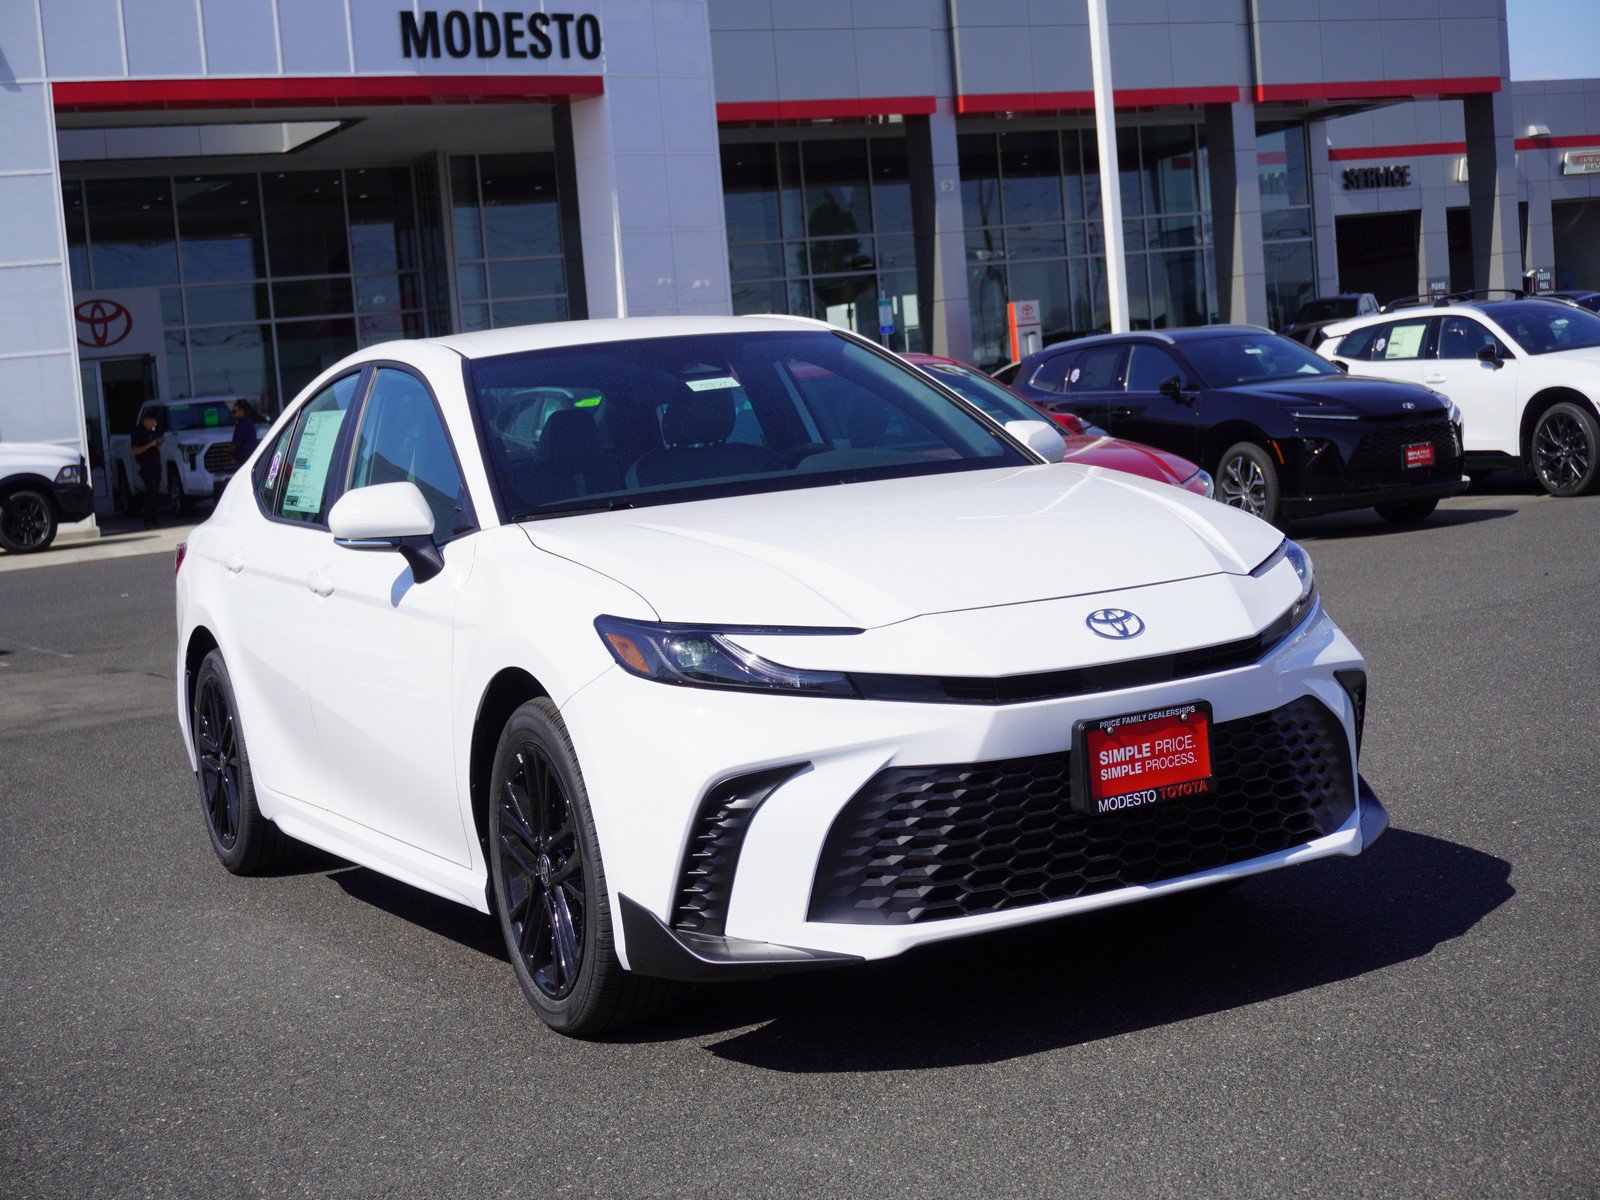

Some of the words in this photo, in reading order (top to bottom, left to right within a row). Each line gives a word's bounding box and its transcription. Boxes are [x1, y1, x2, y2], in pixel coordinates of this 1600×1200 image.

[399, 10, 601, 60] MODESTO
[1343, 165, 1411, 190] SERVICE
[1100, 718, 1120, 729] PRICE
[1122, 714, 1147, 725] FAMILY
[1148, 705, 1195, 720] DEALERSHIPS
[1099, 743, 1151, 765] SIMPLE
[1155, 735, 1196, 754] PRICE.
[1100, 762, 1142, 781] SIMPLE
[1145, 752, 1197, 772] PROCESS.
[1098, 789, 1157, 813] MODESTO
[1159, 780, 1209, 800] TOYOTA
